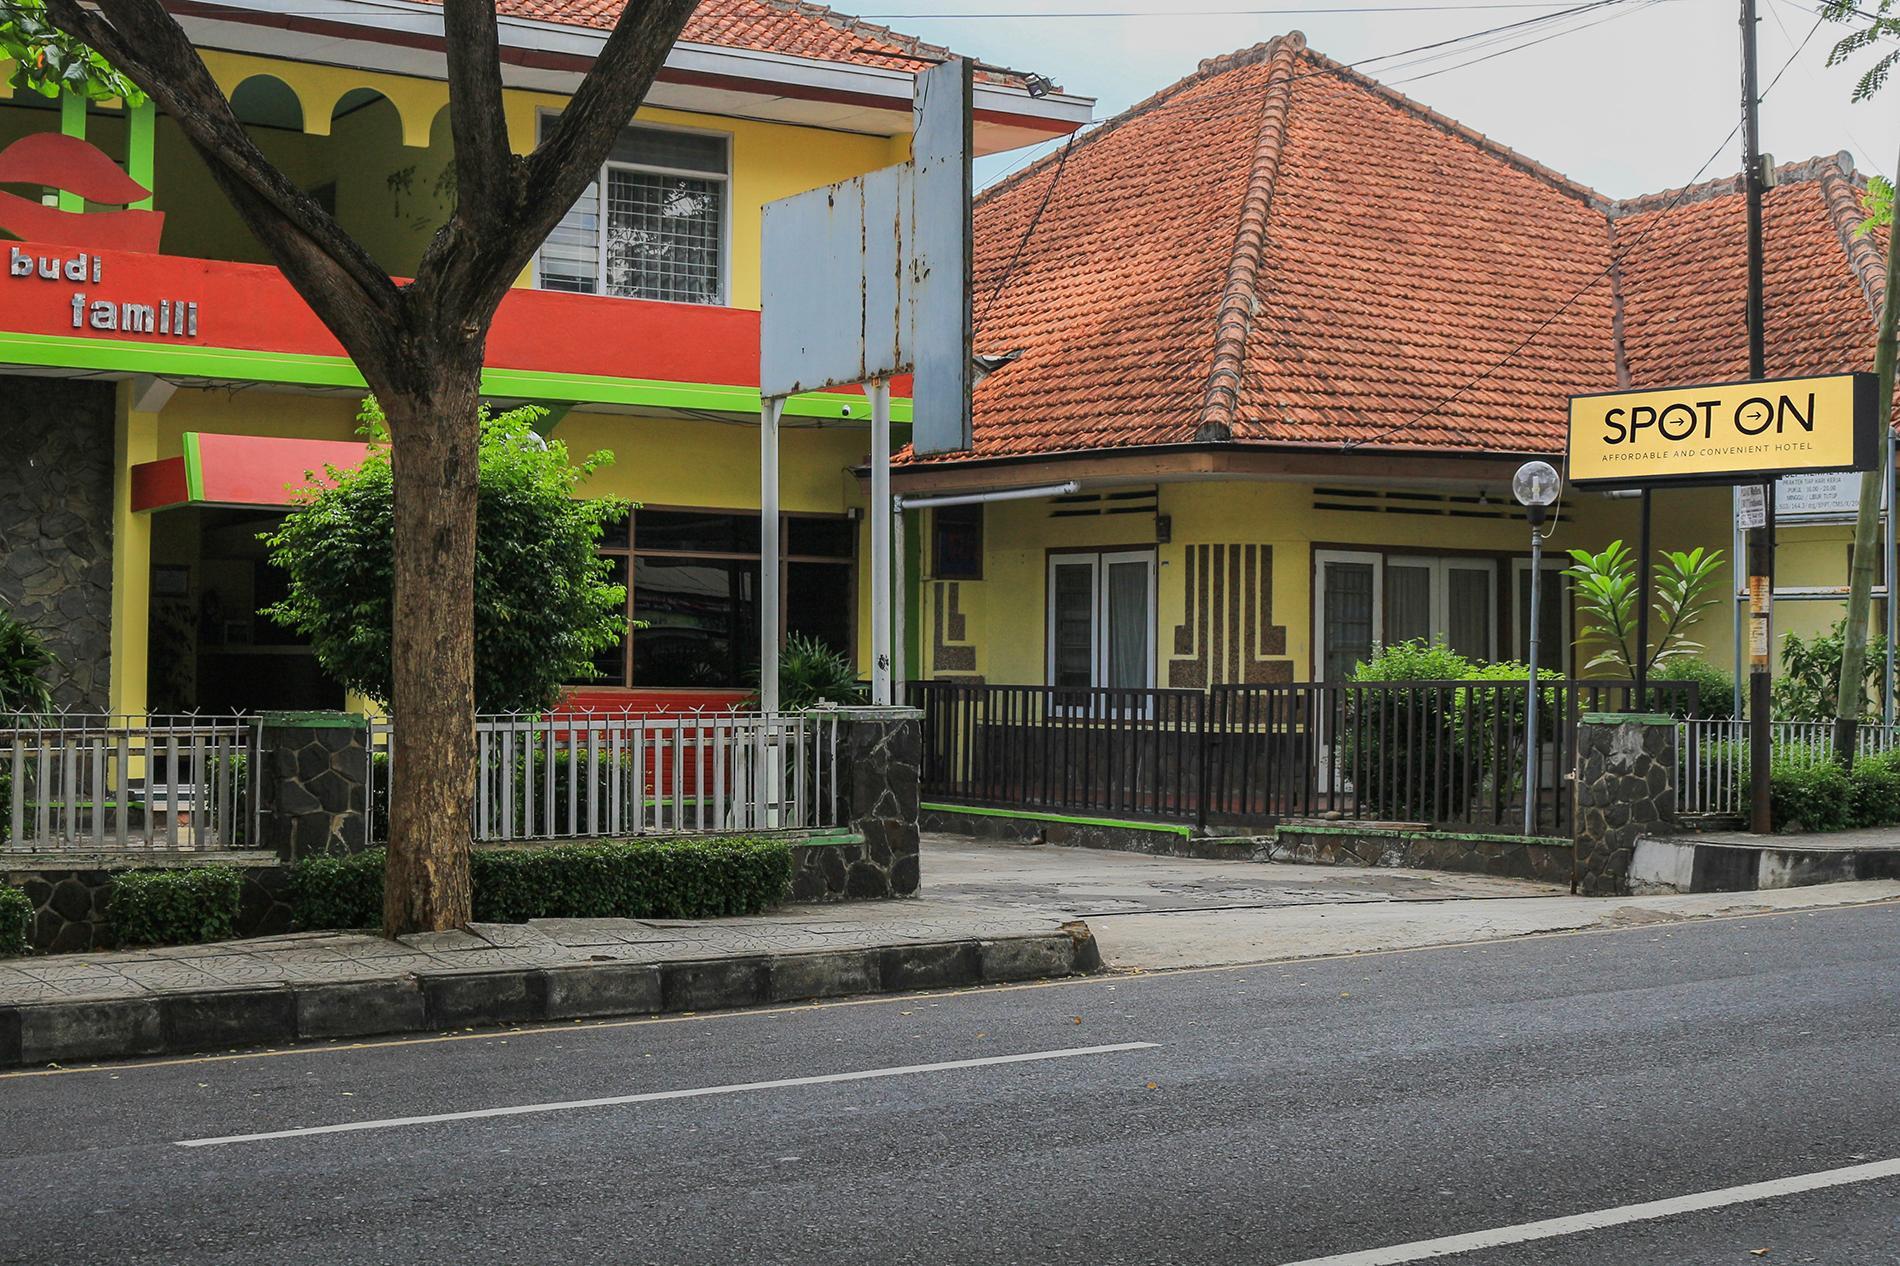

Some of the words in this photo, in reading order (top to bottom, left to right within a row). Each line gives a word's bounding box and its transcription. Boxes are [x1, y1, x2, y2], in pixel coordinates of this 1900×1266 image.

[10, 247, 102, 284] budi
[71, 292, 198, 336] famili
[1602, 400, 1721, 445] SPOT
[1734, 393, 1815, 436] ON
[1601, 450, 1669, 462] AFFORDABLE
[1673, 449, 1696, 458] AND
[1699, 444, 1769, 457] CONVENIENT
[1775, 441, 1813, 452] HOTEL
